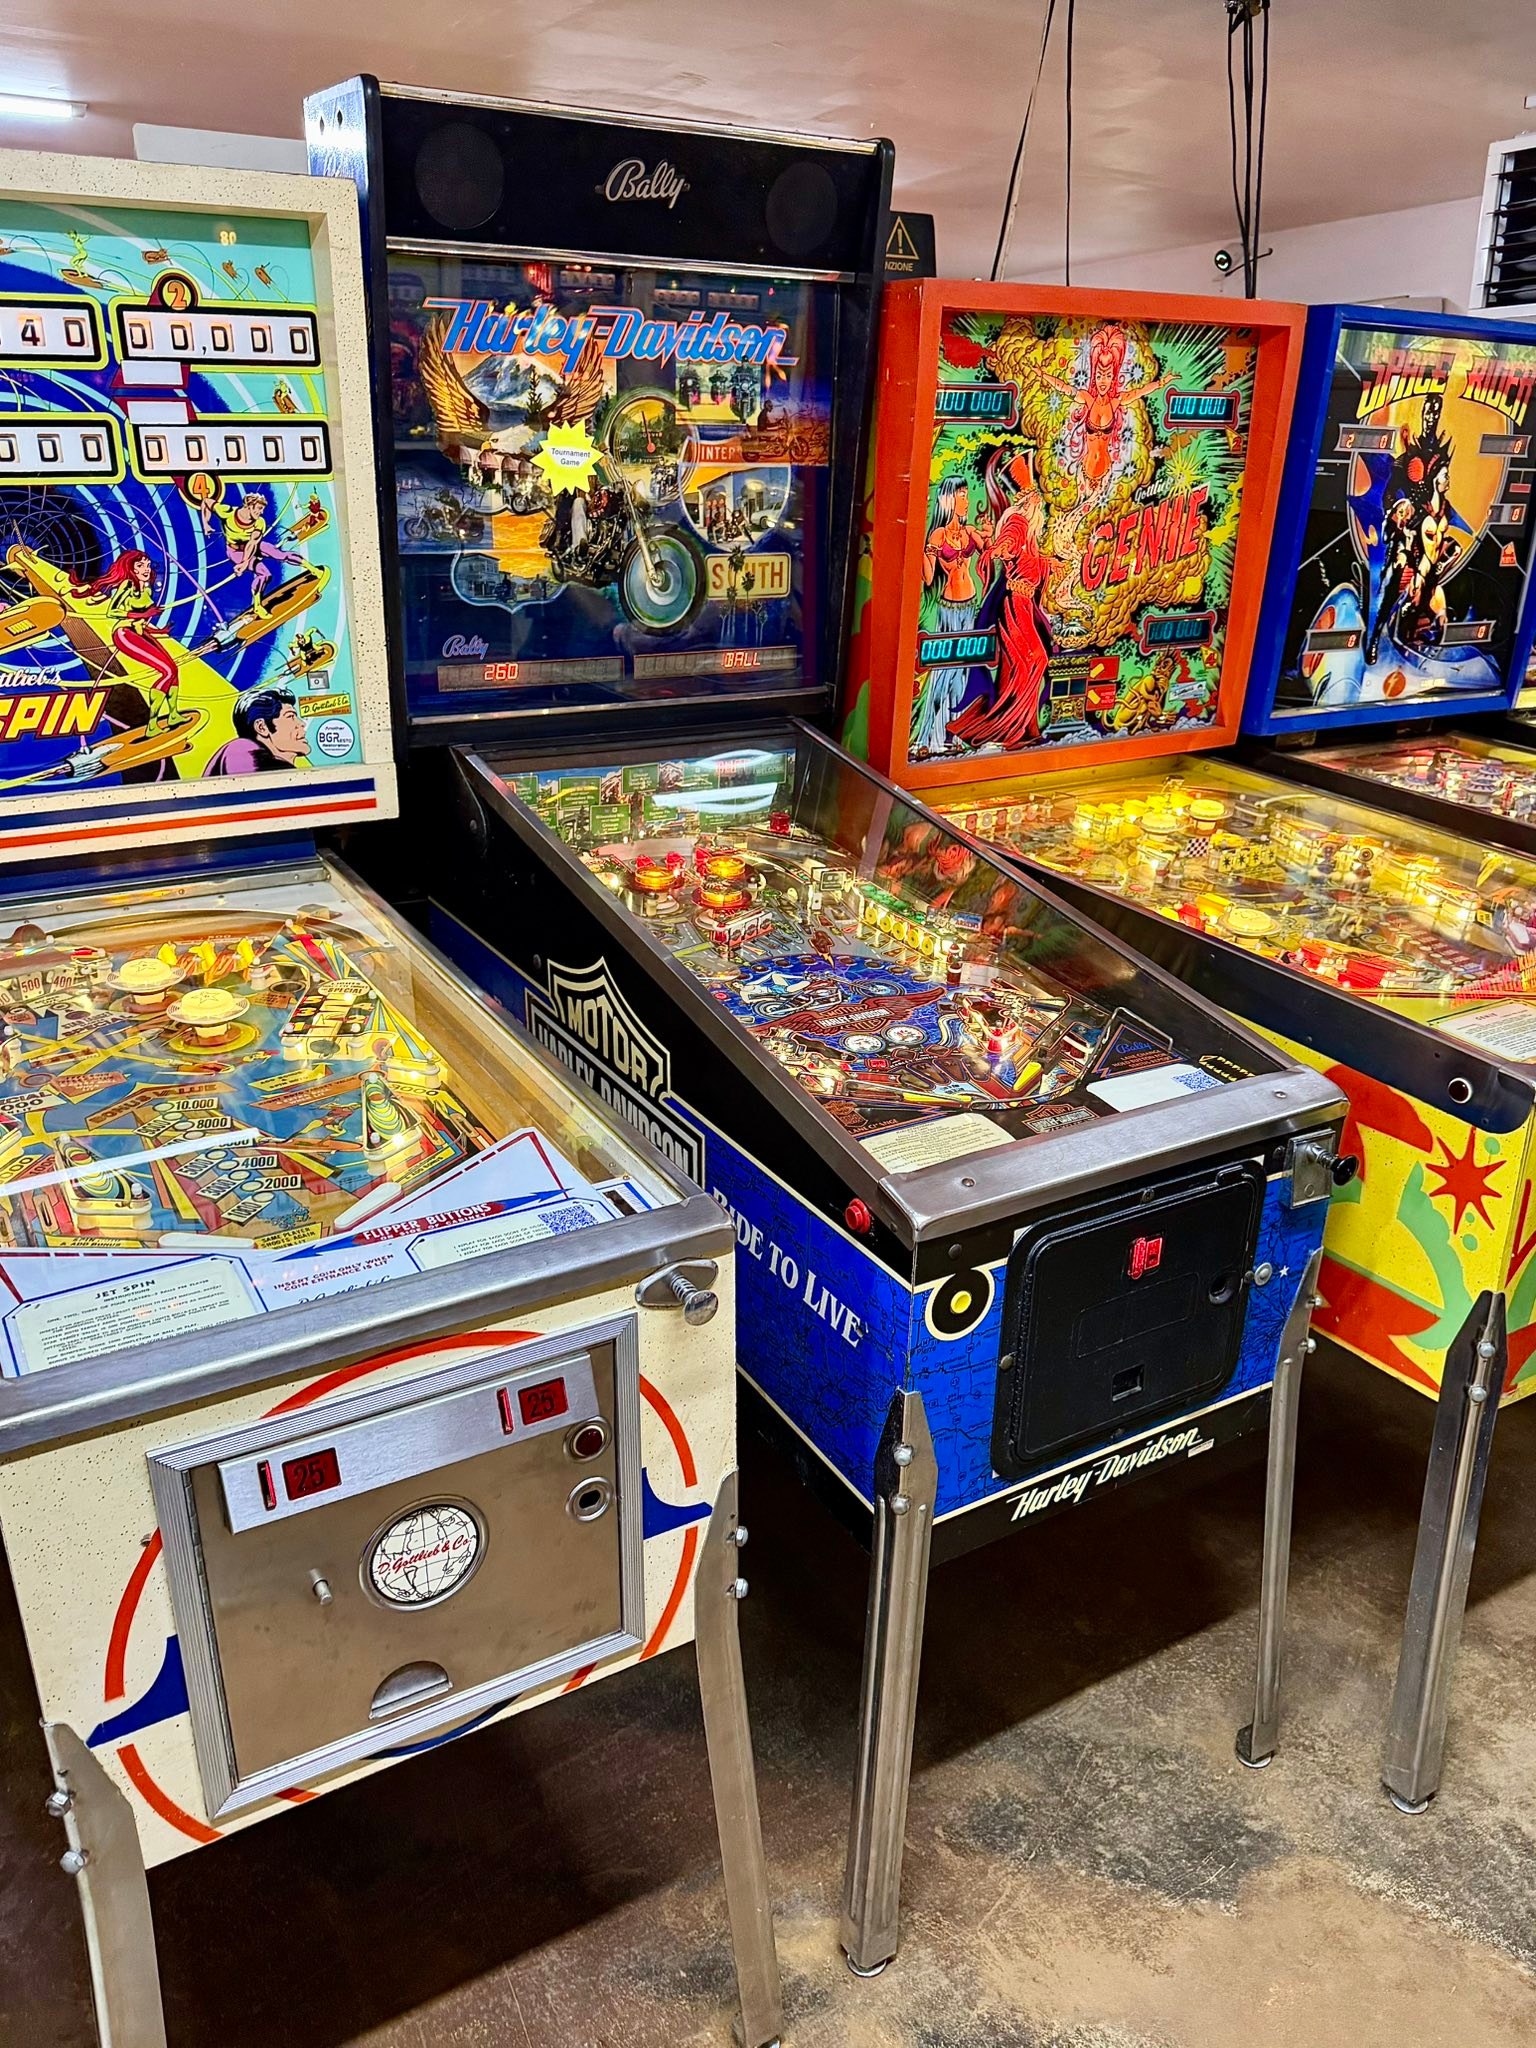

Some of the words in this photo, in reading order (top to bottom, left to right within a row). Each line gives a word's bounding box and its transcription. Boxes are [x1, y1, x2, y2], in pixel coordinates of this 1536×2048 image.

[604, 158, 686, 208] Bally
[167, 281, 188, 309] 2
[423, 296, 799, 374] Harley-Davidson
[1356, 348, 1456, 420] SPACE
[551, 447, 591, 458] Tournament
[560, 458, 580, 467] Game
[192, 474, 210, 498] 4
[1081, 482, 1209, 591] GENIE
[442, 634, 489, 660] Bally
[484, 663, 519, 681] 260
[21, 977, 41, 993] 500
[53, 975, 73, 988] 400
[568, 994, 649, 1092] MOTOR
[1116, 1041, 1152, 1054] Bally
[175, 1098, 214, 1111] 10.000
[197, 1117, 228, 1129] 8000
[179, 1158, 214, 1176] 5000
[241, 1156, 275, 1169] 4000
[200, 1179, 237, 1197] 3000
[263, 1175, 298, 1189] 2000
[227, 1200, 262, 1219] 1000
[362, 1220, 421, 1241] FLIPPER
[425, 1202, 492, 1225] BUTTONS
[261, 1233, 282, 1243] SAME
[282, 1227, 311, 1238] PLAYER
[293, 1231, 316, 1243] AGAIN
[380, 1233, 395, 1241] ON
[400, 1227, 422, 1236] SIDE
[428, 1222, 440, 1230] OF
[273, 1275, 310, 1290] INSERT
[313, 1268, 337, 1279] COIN
[338, 1261, 362, 1273] ONLY
[365, 1253, 395, 1265] WHEN
[283, 1280, 310, 1292] COIN
[311, 1268, 362, 1285] ENTRANCE
[362, 1263, 373, 1271] IS
[375, 1259, 389, 1268] LIT
[95, 1288, 117, 1300] JET
[122, 1279, 156, 1293] SPIN
[769, 1241, 799, 1289] TO
[803, 1269, 861, 1349] LIVE
[1006, 1427, 1204, 1522] Harley-Davidson
[377, 1561, 391, 1576] D.
[392, 1543, 440, 1574] Gottlieb
[440, 1540, 451, 1553] &
[452, 1534, 472, 1551] Co.
